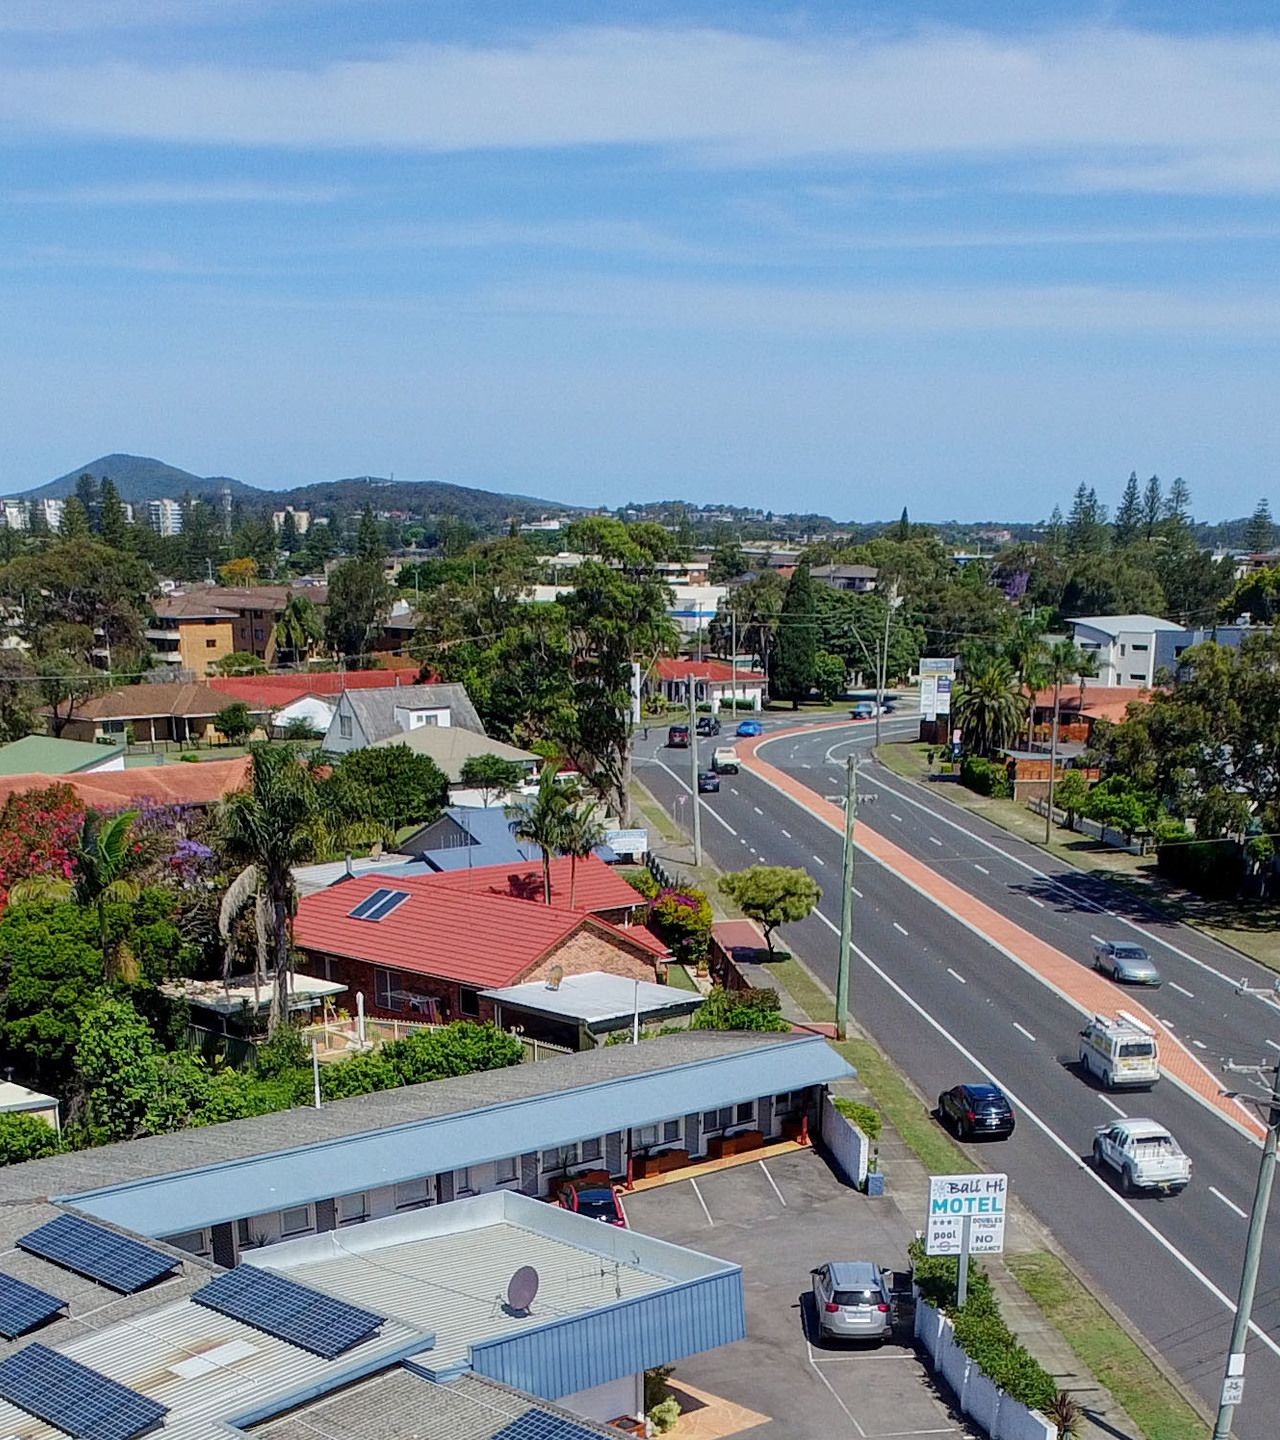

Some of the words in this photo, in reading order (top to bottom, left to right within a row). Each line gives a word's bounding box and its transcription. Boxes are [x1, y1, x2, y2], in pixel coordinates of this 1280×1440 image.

[946, 1179, 981, 1194] Bali
[986, 1178, 1005, 1193] Hi
[932, 1197, 1003, 1214] MOTEL
[934, 1230, 956, 1241] pool
[975, 1235, 993, 1243] NO
